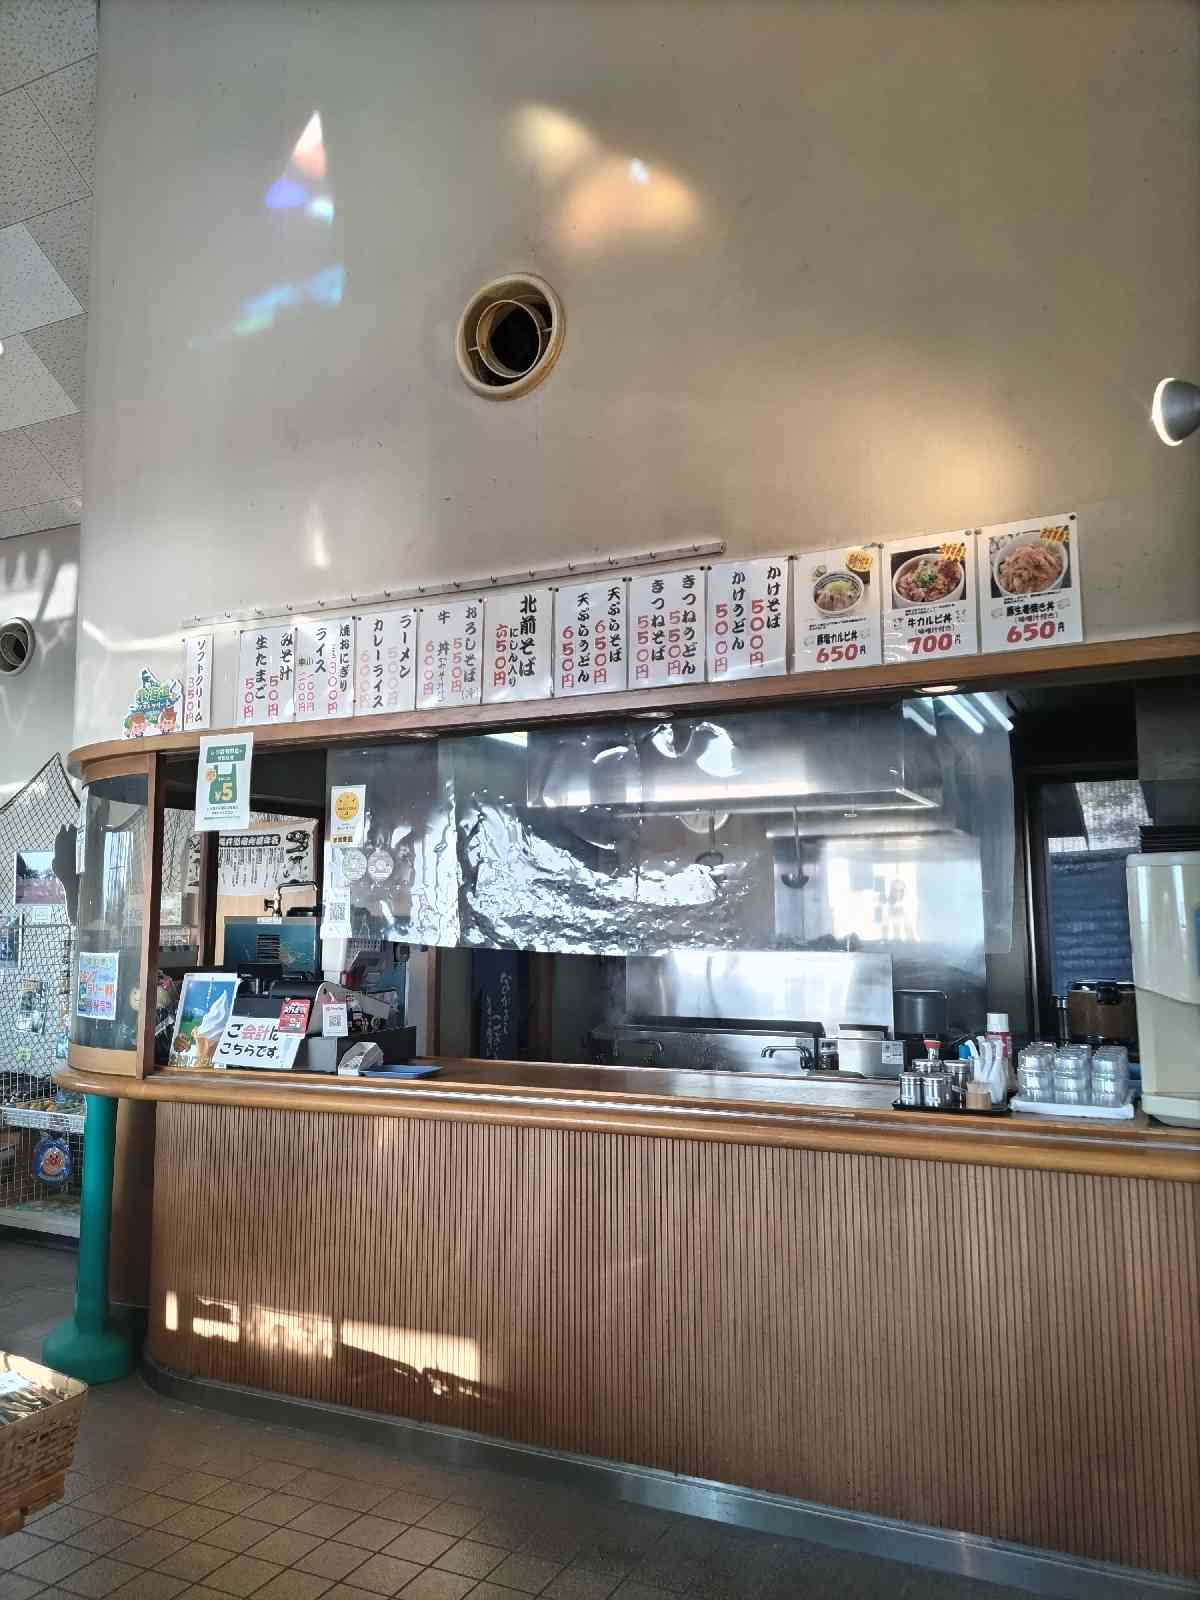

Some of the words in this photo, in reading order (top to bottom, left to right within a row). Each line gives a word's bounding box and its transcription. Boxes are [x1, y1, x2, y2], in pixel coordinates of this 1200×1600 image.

[608, 586, 622, 663] 天ぷらそば
[651, 579, 665, 662] きつねそば
[681, 574, 697, 675] きつねうどん
[732, 571, 746, 651] かけうどん
[765, 566, 781, 629] かけそば
[1007, 620, 1065, 643] 650円
[255, 634, 269, 700] 生たまご
[279, 632, 294, 681] みそ汁
[315, 627, 327, 674] ライス
[339, 623, 351, 693] 焼おにぎり
[372, 619, 384, 709] カレーライス
[400, 614, 412, 679] ラーメン
[463, 606, 478, 683] おろしそば
[507, 627, 519, 688] にしん入り
[519, 594, 537, 678] 北前そば
[577, 592, 590, 683] 天ぷらうどん
[816, 643, 866, 663] 650円
[907, 633, 961, 654] 700円
[194, 639, 207, 723] ソフトクリーム
